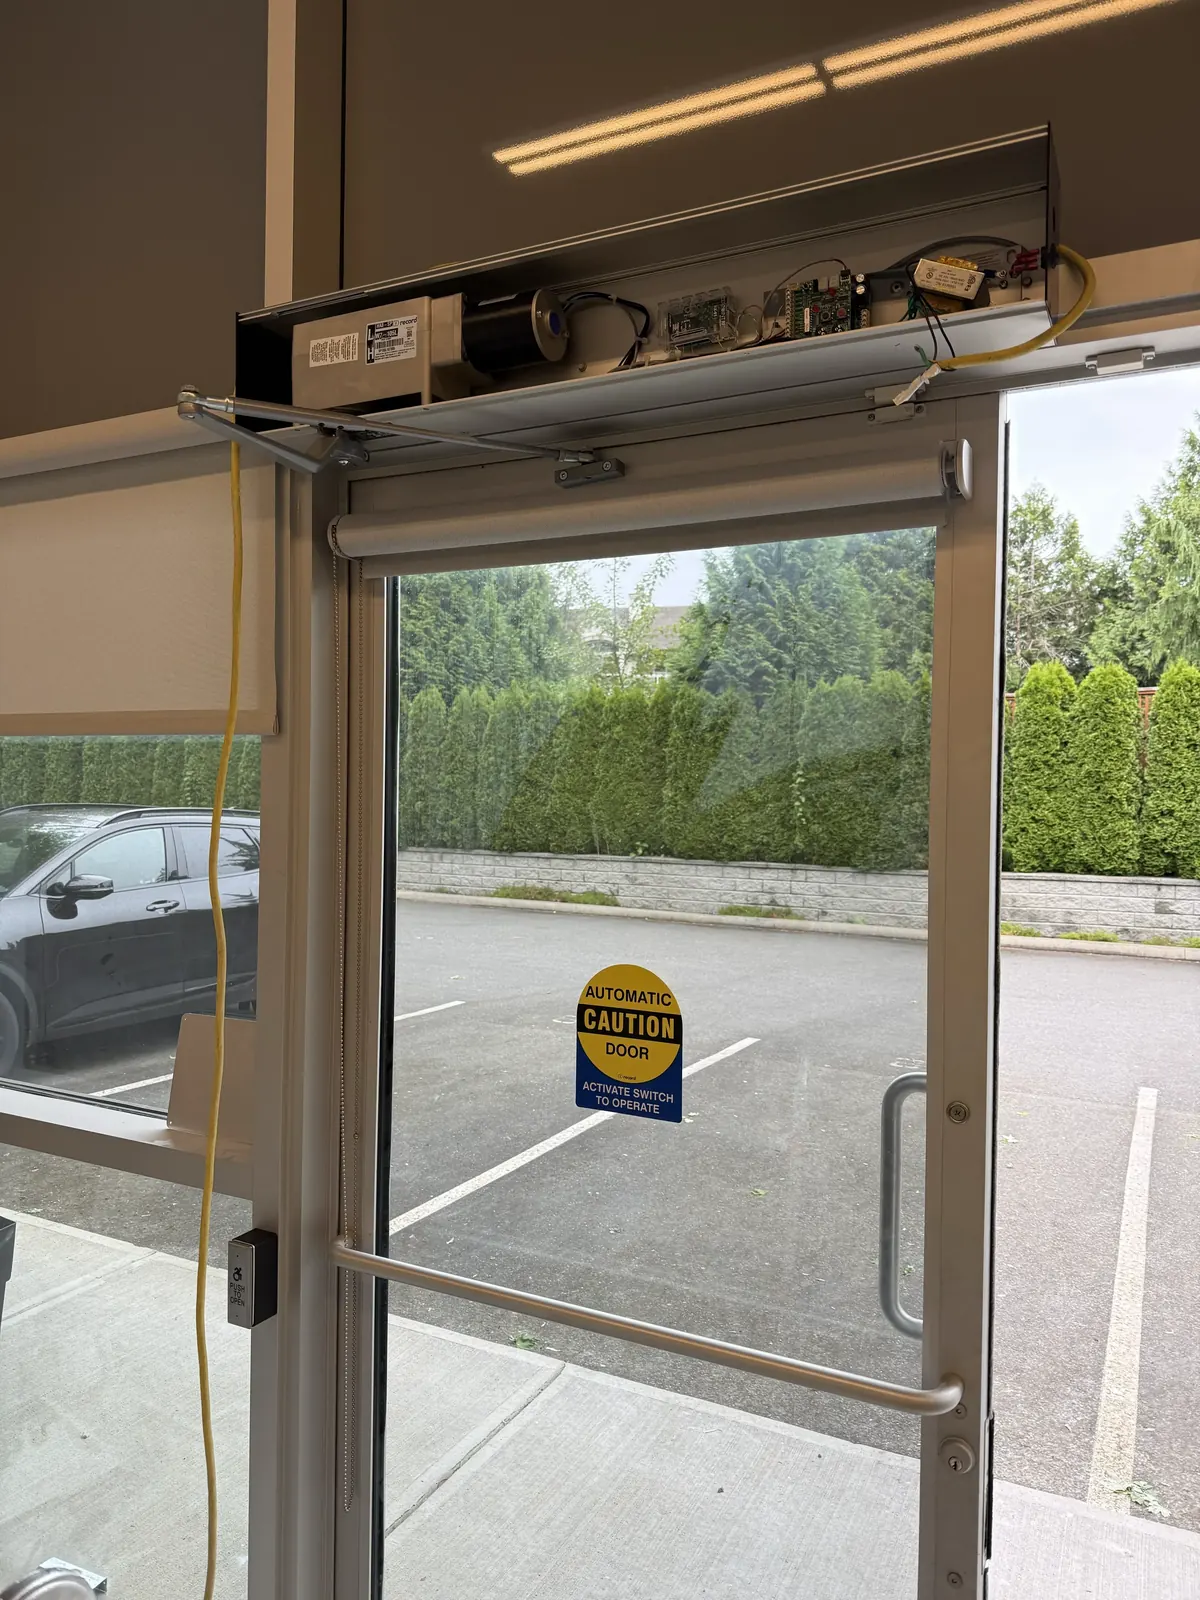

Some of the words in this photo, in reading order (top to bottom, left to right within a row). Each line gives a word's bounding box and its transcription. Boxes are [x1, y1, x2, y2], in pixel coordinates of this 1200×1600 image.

[400, 317, 418, 326] record
[585, 985, 672, 1007] AUTOMATIC
[583, 1008, 675, 1039] CAUTION
[605, 1042, 649, 1060] DOOR
[582, 1081, 631, 1097] ACTIVATE
[633, 1088, 674, 1104] SWITCH
[596, 1095, 610, 1106] TO
[612, 1097, 660, 1114] OPERATE
[229, 1282, 245, 1293] PUSH
[234, 1290, 242, 1299] TO
[229, 1296, 245, 1307] OPEN
